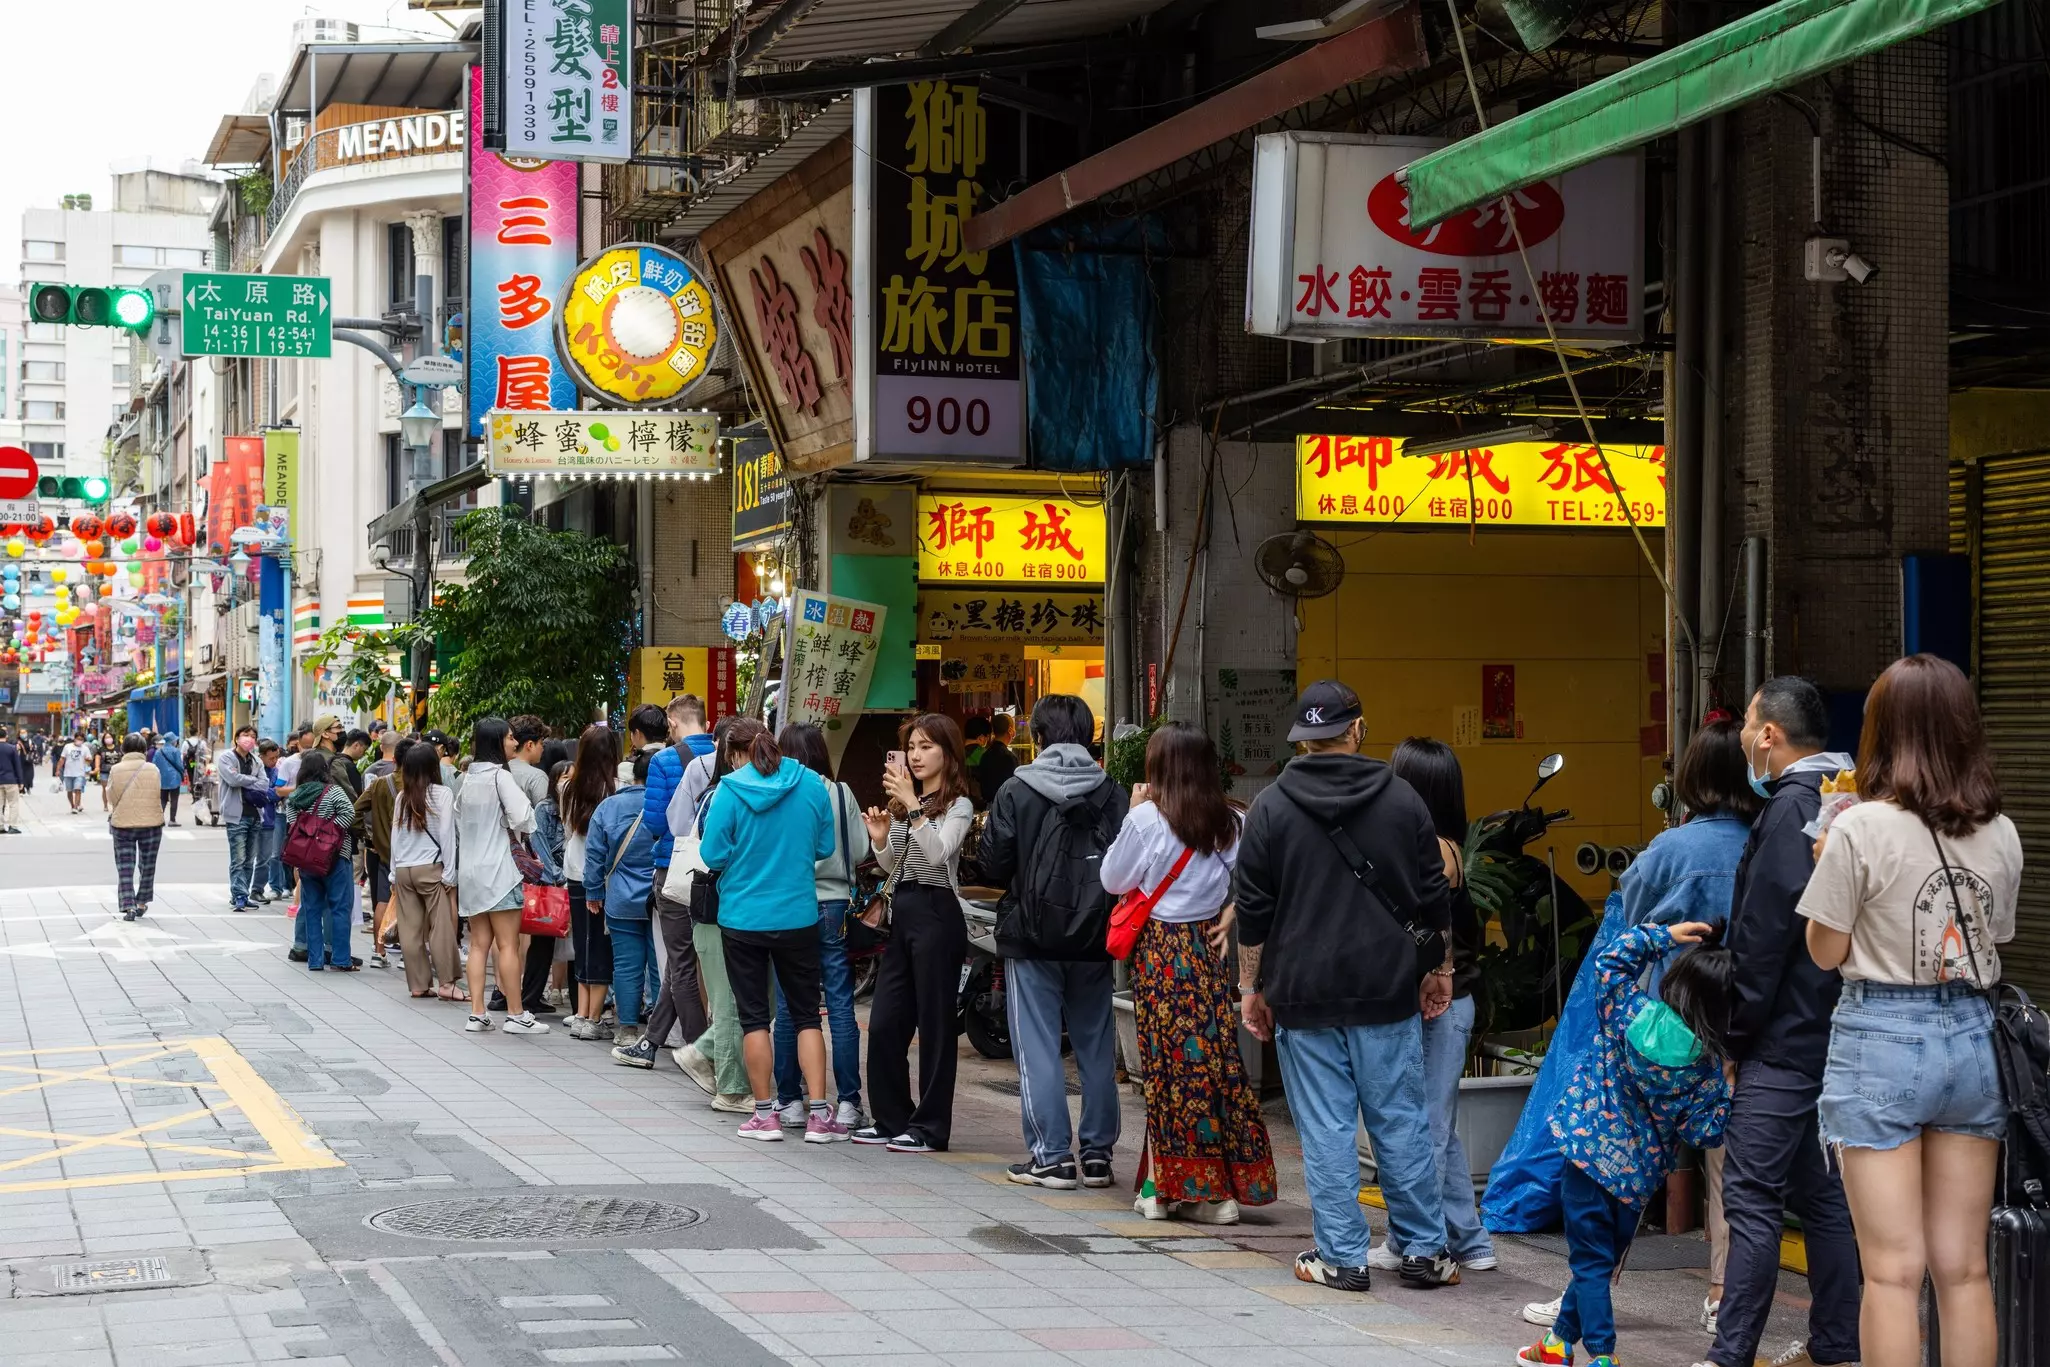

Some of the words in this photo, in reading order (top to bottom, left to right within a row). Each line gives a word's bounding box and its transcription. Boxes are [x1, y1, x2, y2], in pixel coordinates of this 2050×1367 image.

[600, 24, 620, 113] 請上2樓
[337, 113, 463, 160] MEANDE
[198, 280, 316, 305] 太原路
[497, 197, 552, 410] 三多屋
[203, 307, 273, 322] TaiYuan
[286, 310, 311, 324] Rd.
[881, 275, 1015, 358] 旅店
[955, 363, 1001, 374] HOTEL
[514, 419, 582, 453] 蜂蜜
[628, 419, 695, 452] 檸檬
[906, 395, 991, 436] 900
[557, 456, 660, 465] 台湾風味のハニーレモン
[1305, 434, 1664, 496] 獅城旅
[736, 458, 760, 513] 181
[928, 502, 1084, 561] 獅城
[728, 611, 749, 632] 春
[805, 602, 824, 620] 冰
[853, 611, 872, 632] 熱
[834, 640, 865, 696] 蜂蜜
[803, 693, 842, 717] 兩顆
